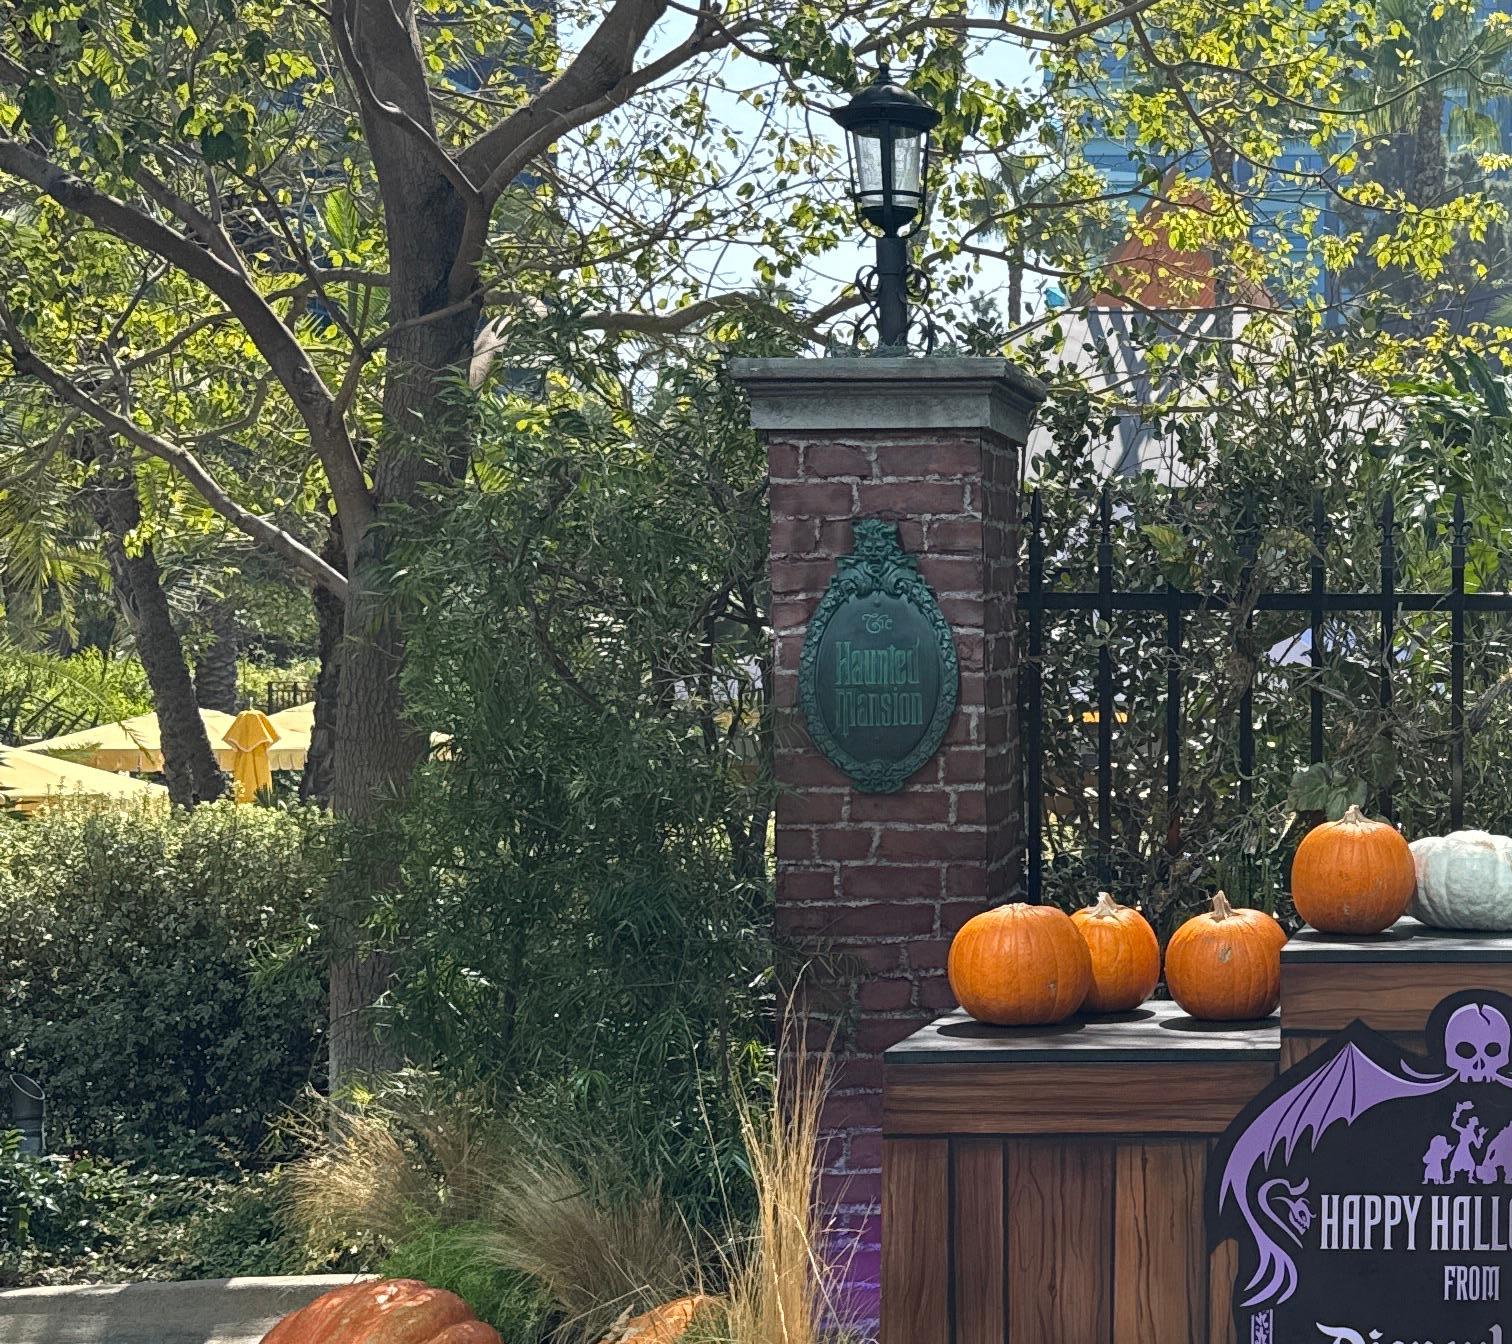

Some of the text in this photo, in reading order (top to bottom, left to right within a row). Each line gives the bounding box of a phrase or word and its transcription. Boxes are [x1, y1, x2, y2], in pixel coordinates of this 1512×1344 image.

[834, 635, 920, 685] Haunted
[832, 687, 923, 737] Mansion
[1319, 1193, 1422, 1252] HAPPY
[1443, 1264, 1501, 1302] FROM
